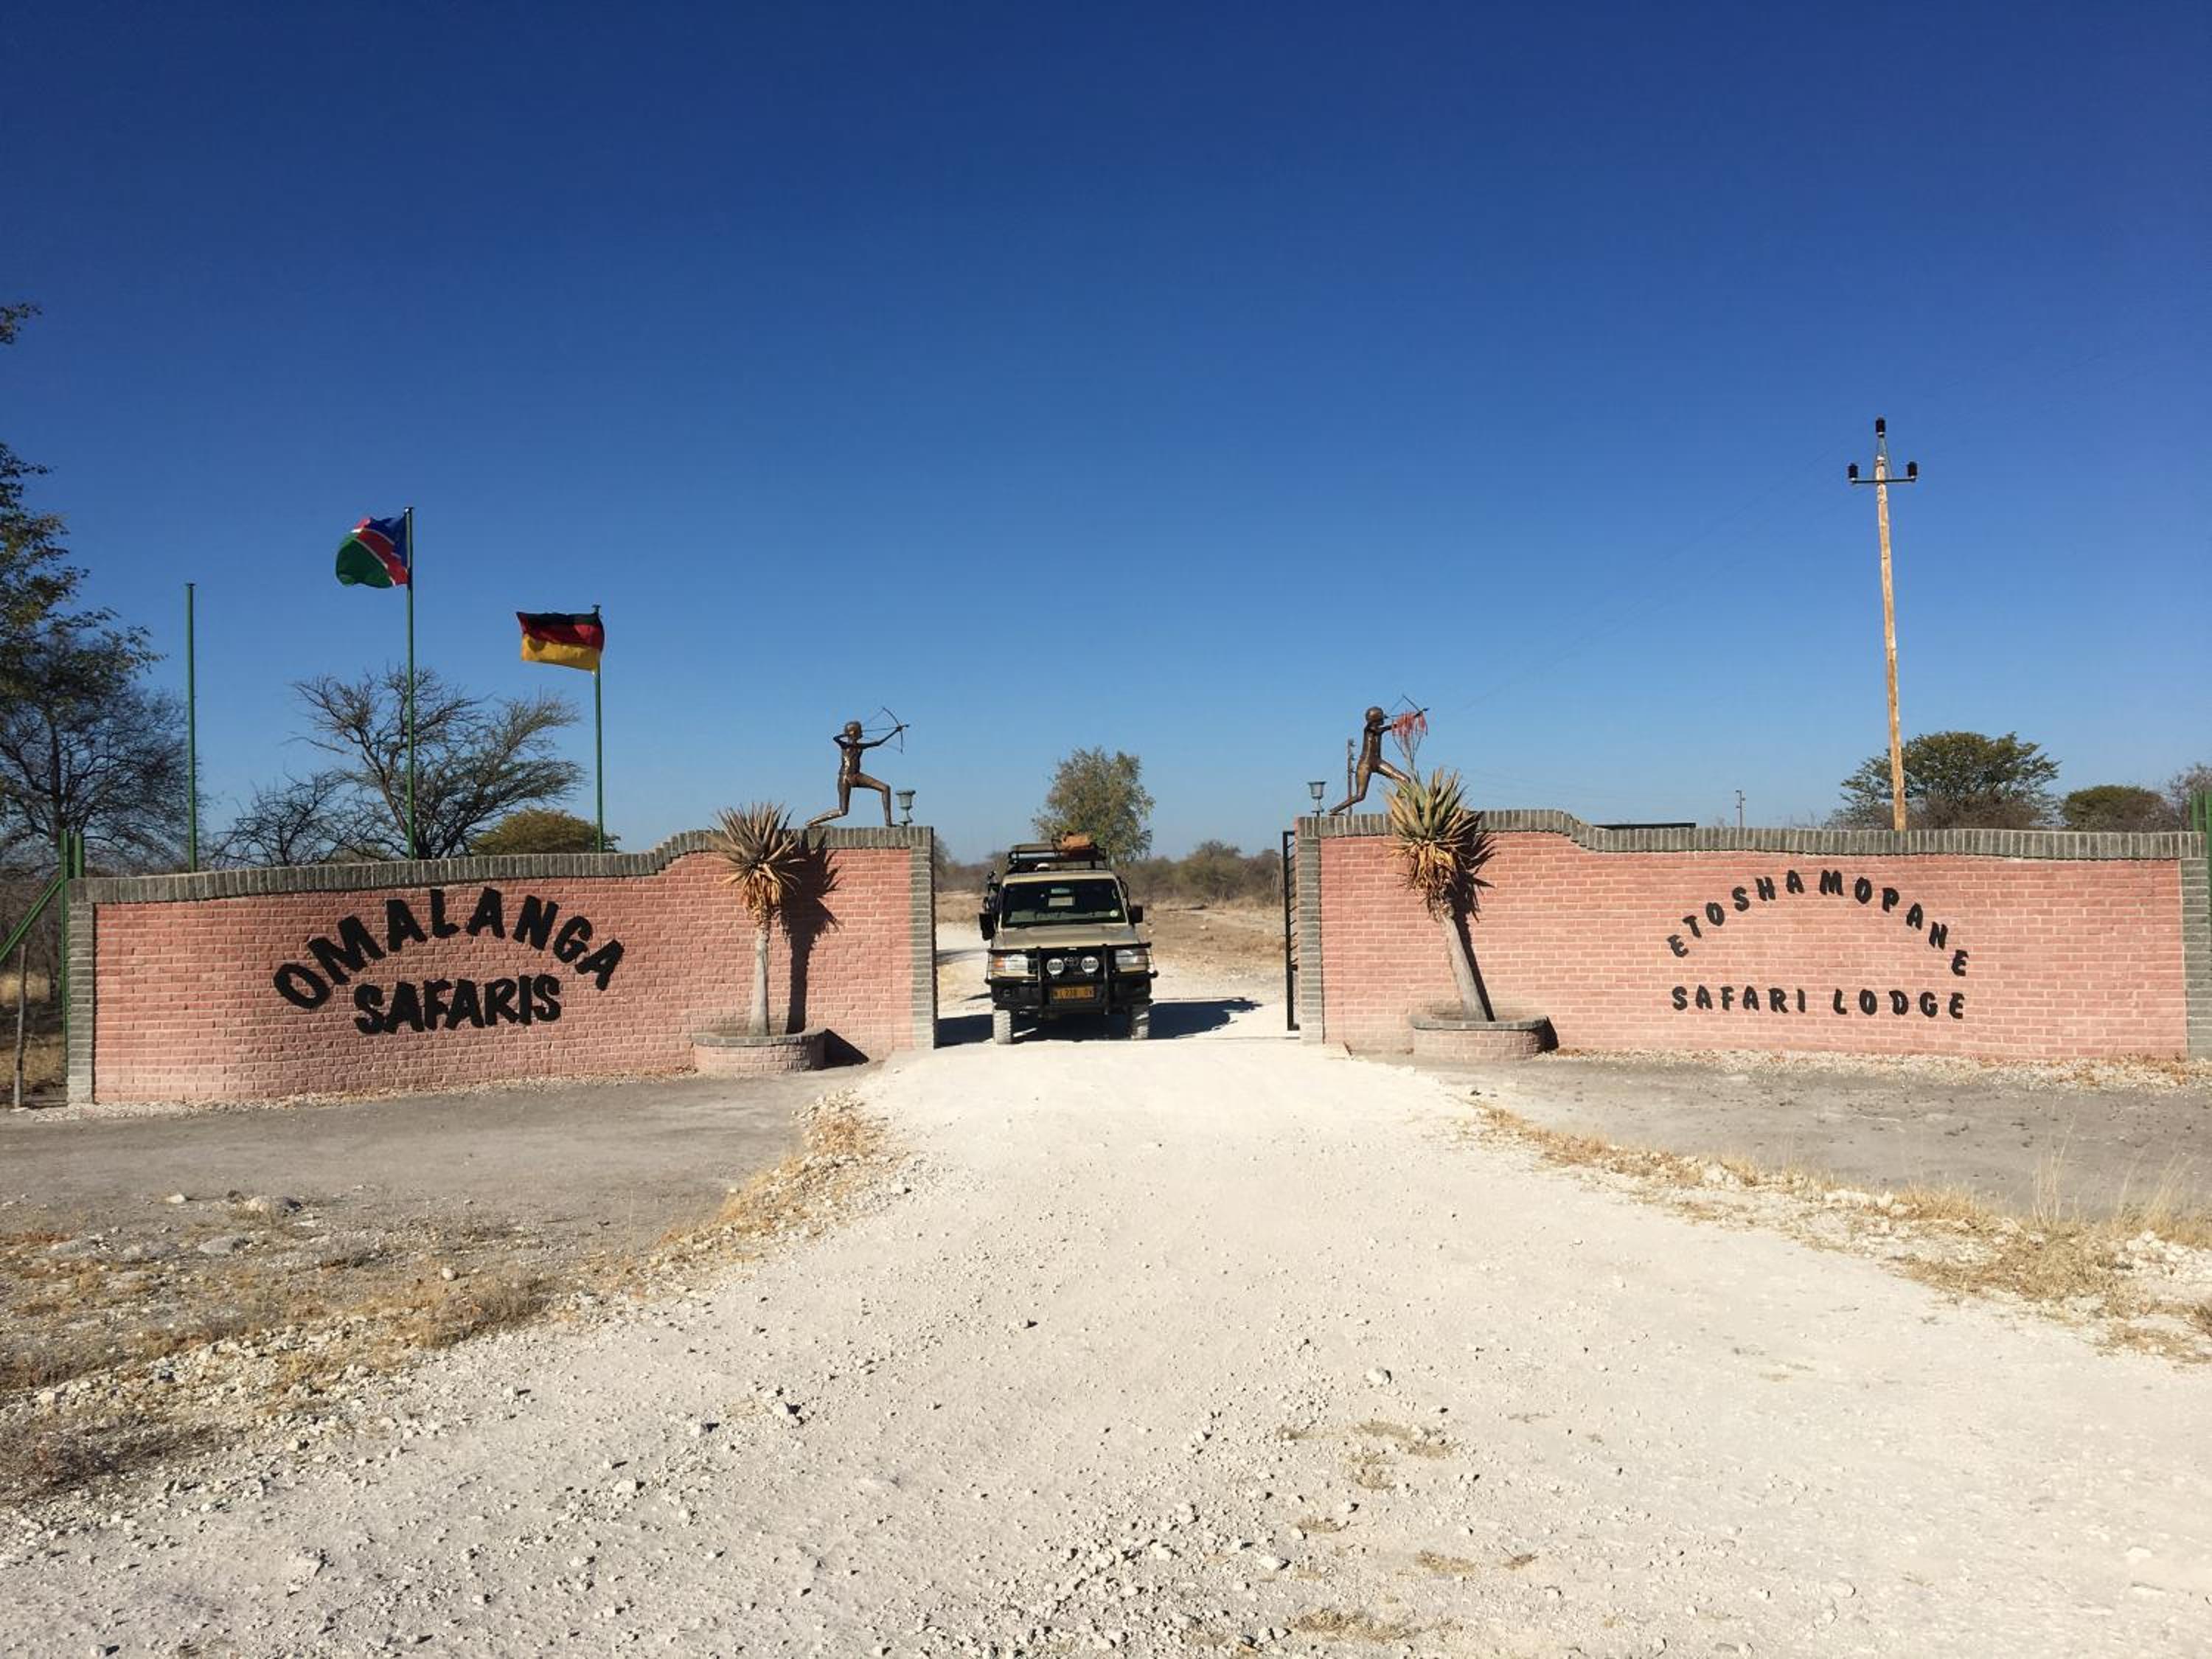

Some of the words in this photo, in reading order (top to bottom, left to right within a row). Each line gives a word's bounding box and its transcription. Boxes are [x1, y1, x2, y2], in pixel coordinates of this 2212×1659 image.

[273, 887, 625, 1009] OMALANGA
[1667, 869, 1969, 976] ETOSHAMOPANE
[353, 973, 562, 1034] SAFARIS
[1672, 984, 1806, 1014] SAFARI
[1832, 988, 1965, 1019] LODGE
